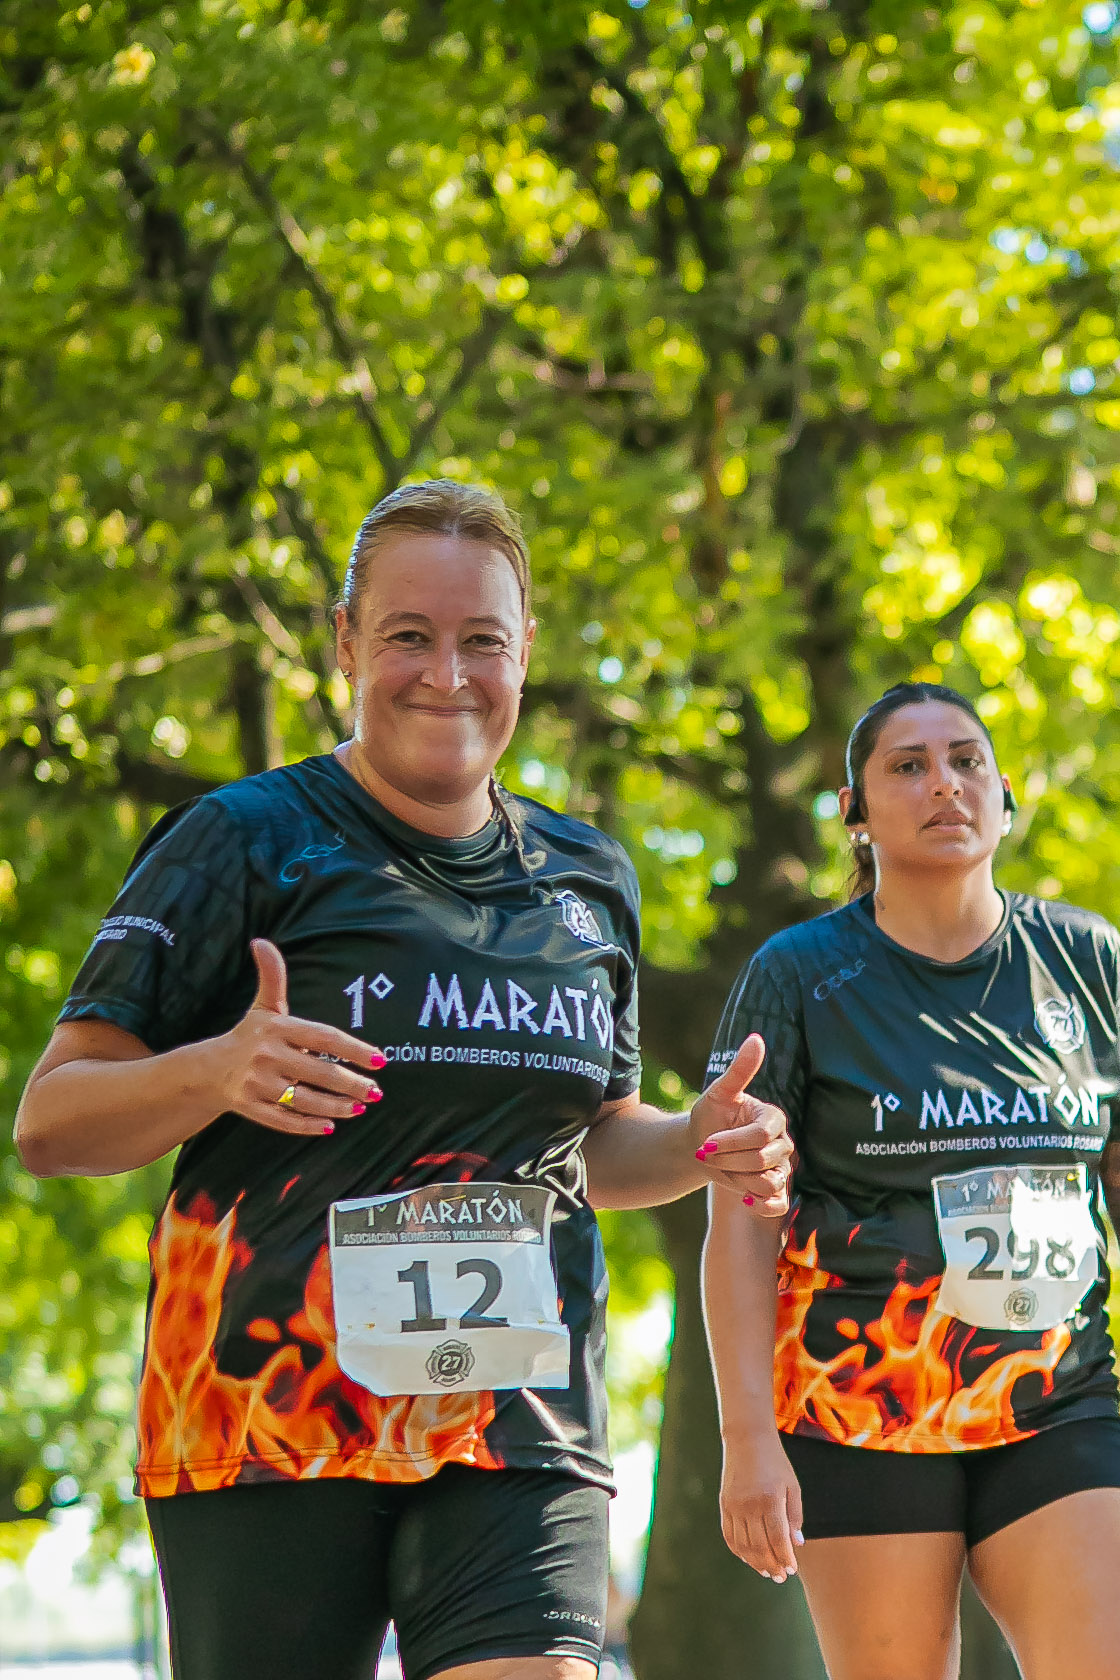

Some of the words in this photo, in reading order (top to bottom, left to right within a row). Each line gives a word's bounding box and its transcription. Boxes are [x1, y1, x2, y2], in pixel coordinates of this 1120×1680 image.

[343, 972, 395, 1029] 1°
[430, 1046, 520, 1067] BOMBEROS
[870, 1092, 901, 1132] 1°
[919, 1074, 1100, 1130] MARATÓN
[855, 1139, 927, 1155] ASOCIACIÓN
[930, 1137, 996, 1152] BOMBEROS
[999, 1135, 1073, 1149] VOLUNTARIOS
[396, 1190, 524, 1225] MARATÓN
[964, 1226, 1076, 1281] 298
[397, 1258, 511, 1333] 12
[441, 1354, 461, 1371] 27
